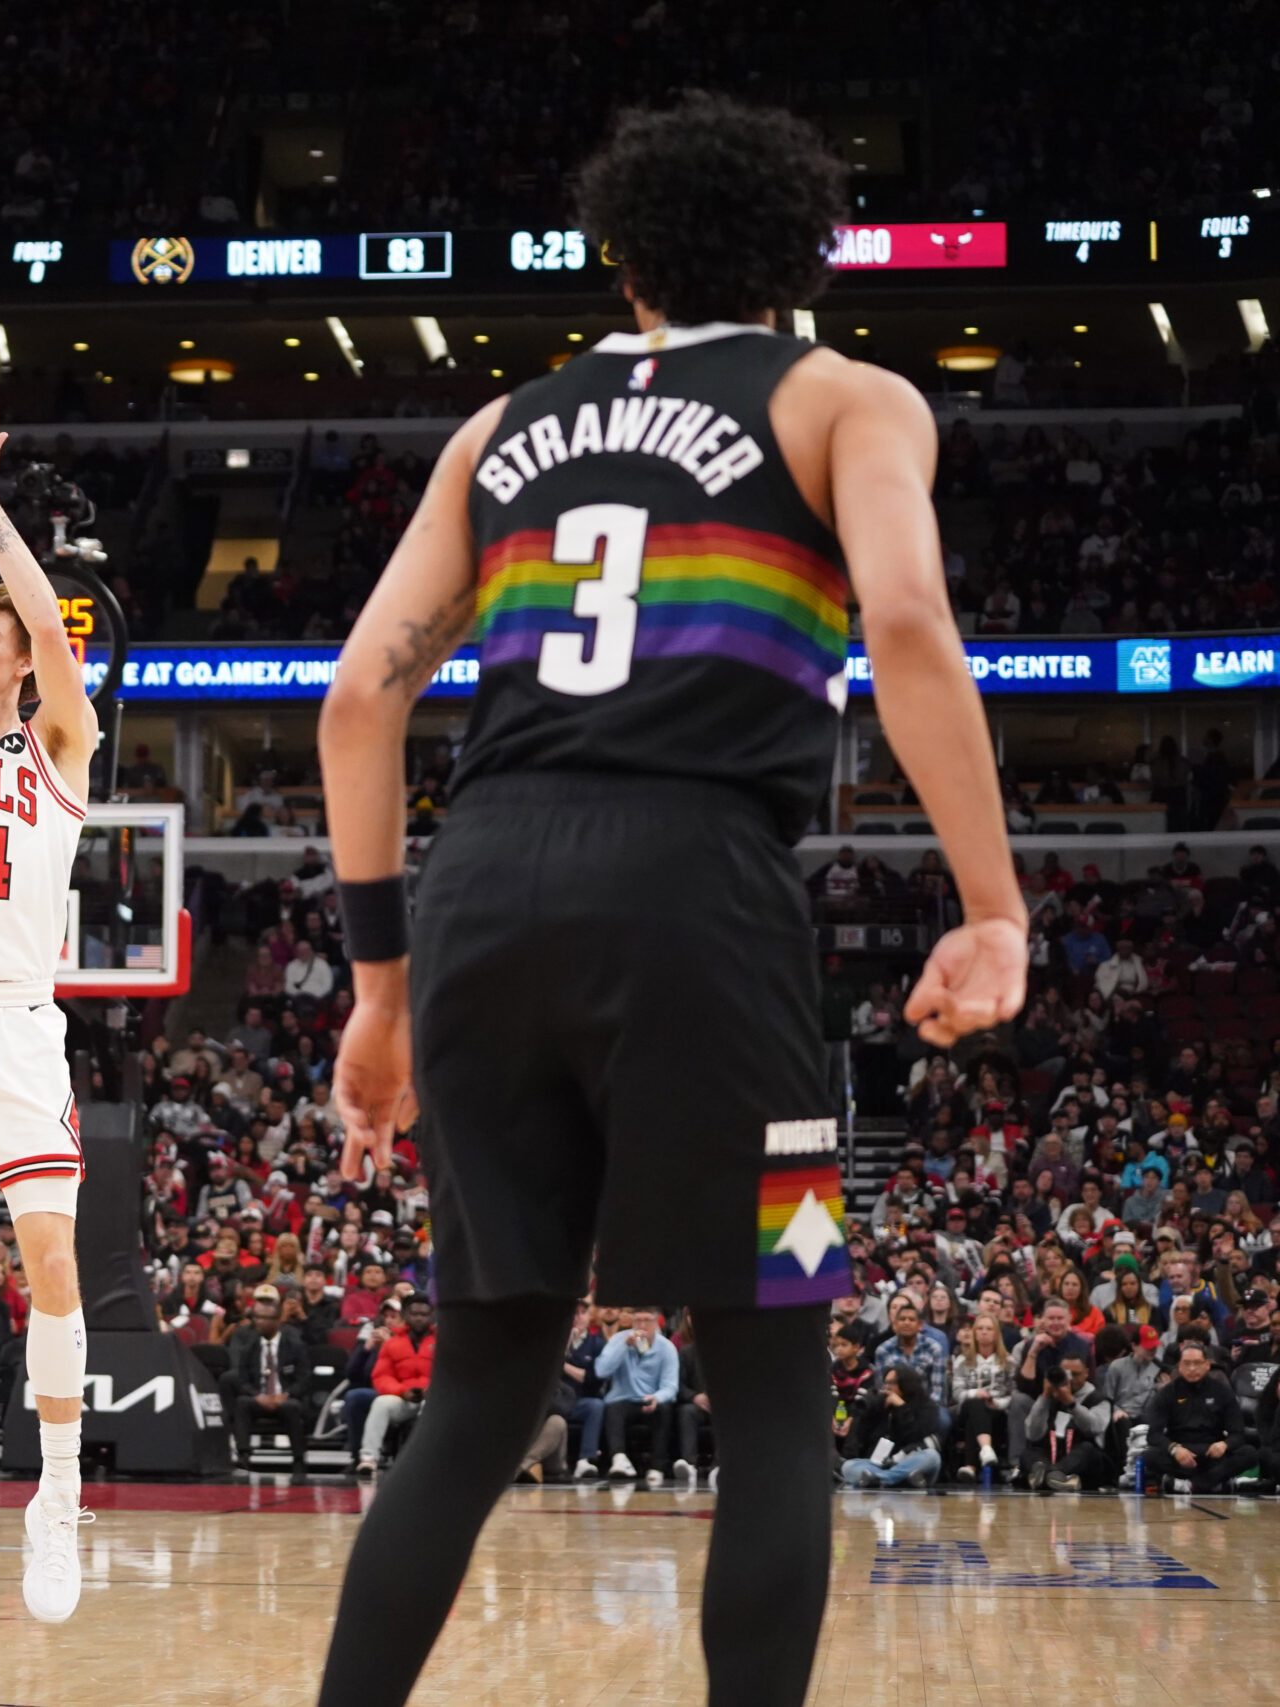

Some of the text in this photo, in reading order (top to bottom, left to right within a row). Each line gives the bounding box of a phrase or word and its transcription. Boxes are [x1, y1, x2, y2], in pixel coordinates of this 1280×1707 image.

[1045, 221, 1121, 242] TIMEOUTS
[1201, 215, 1250, 237] FOULS
[13, 241, 63, 263] FOULS
[227, 239, 321, 276] DENVER
[387, 238, 424, 273] 83
[511, 230, 586, 270] 6:25
[1075, 242, 1090, 263] 4
[1218, 237, 1233, 258] 3
[476, 396, 765, 505] STRAWTHER
[537, 503, 649, 697] 3
[142, 662, 174, 686] AT
[1195, 649, 1275, 677] LEARN
